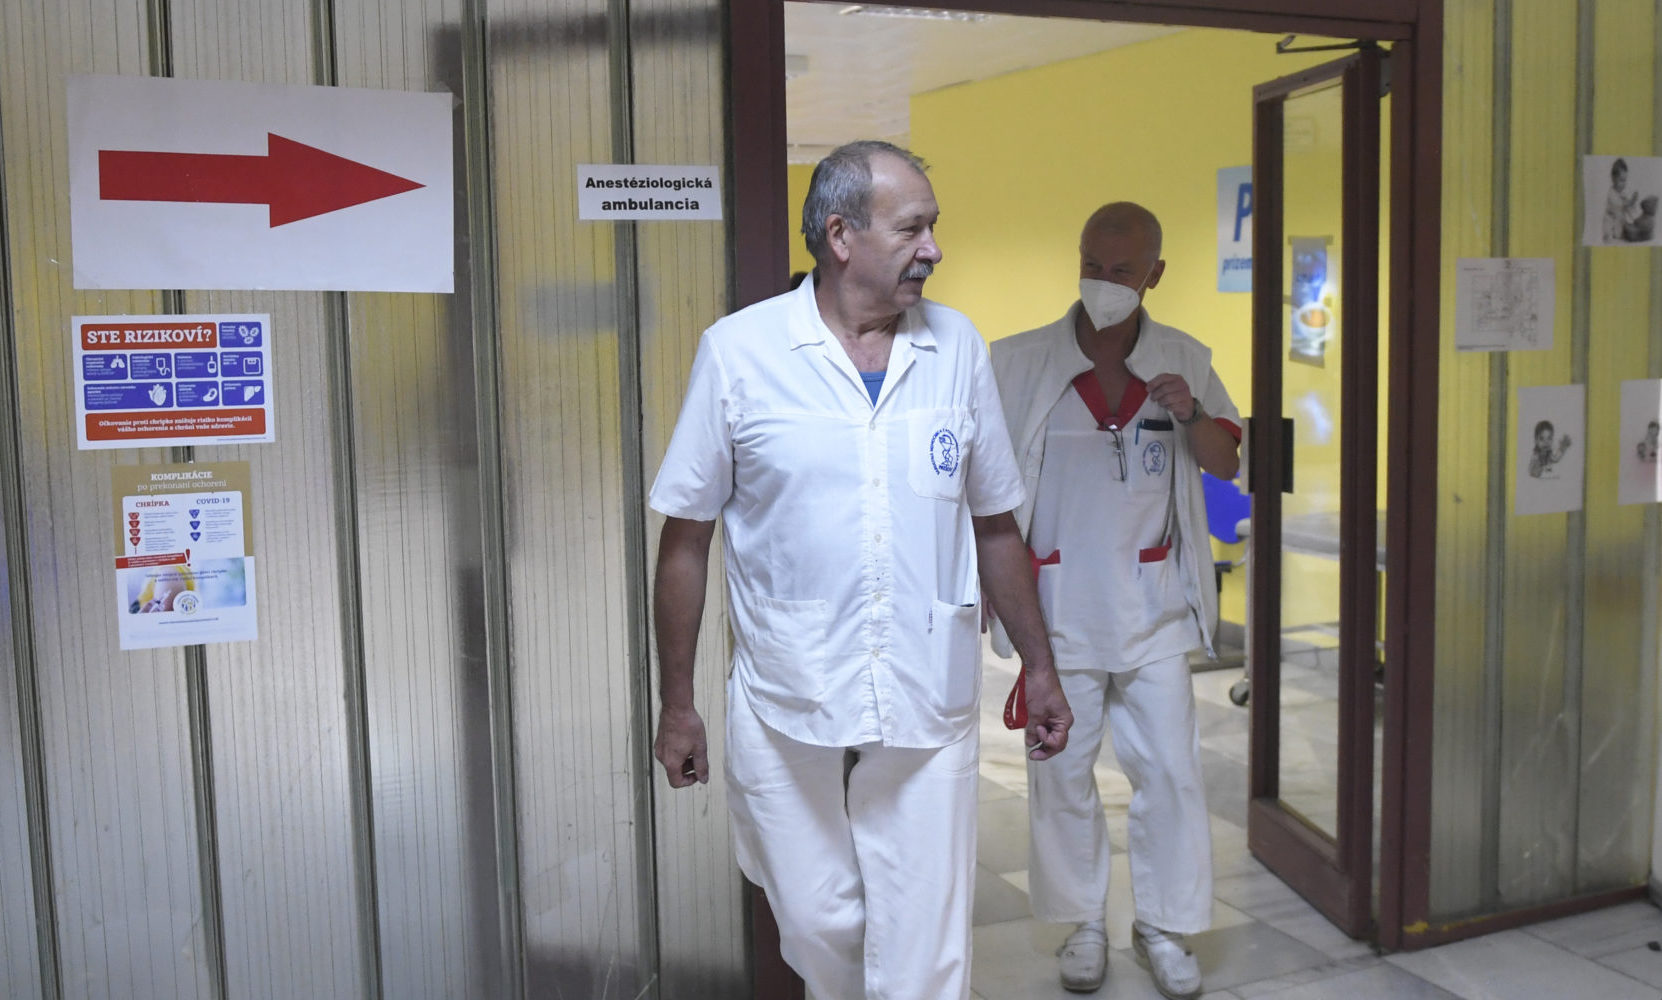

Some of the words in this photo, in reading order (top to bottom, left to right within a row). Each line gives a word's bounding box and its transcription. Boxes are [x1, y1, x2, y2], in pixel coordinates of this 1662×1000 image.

[585, 177, 712, 190] Anestéziologická
[601, 198, 699, 210] ambulancia
[87, 330, 120, 344] STE
[124, 325, 212, 343] RIZIKOVÍ?
[151, 470, 213, 481] KOMPLIKÁCIE
[135, 500, 170, 508] CHRÍPKA
